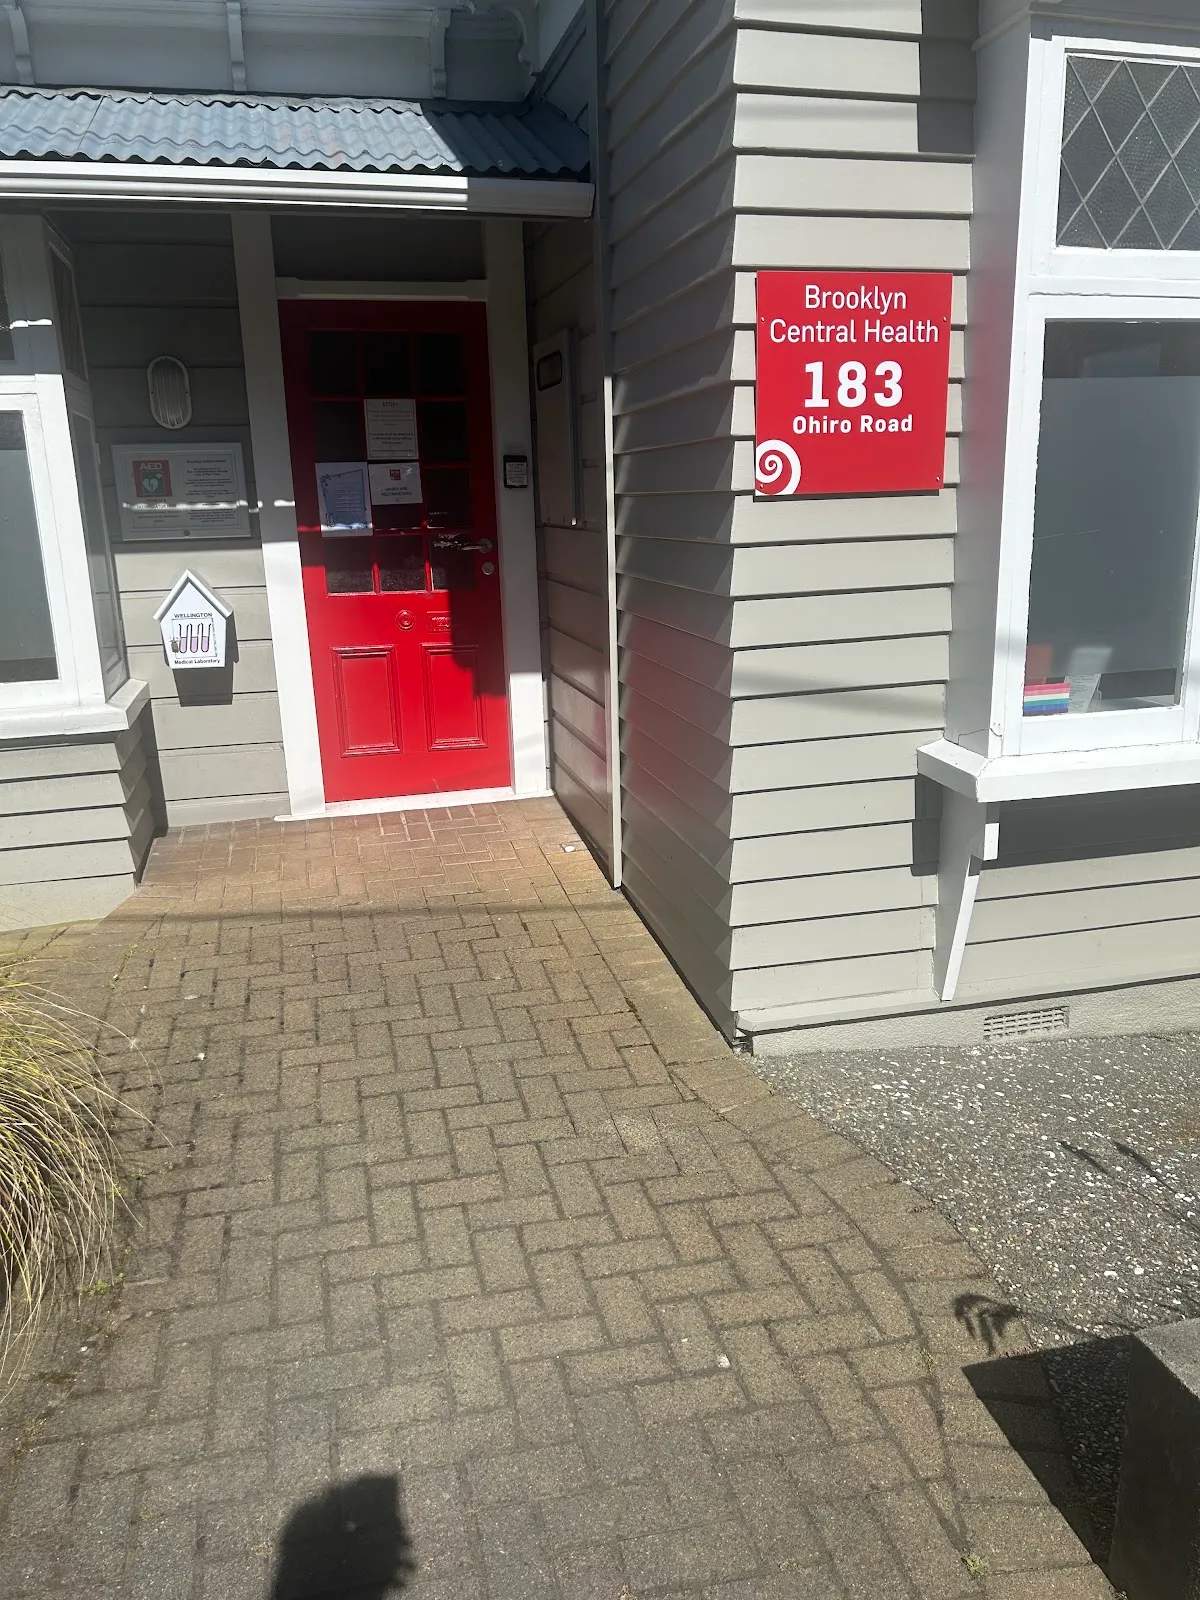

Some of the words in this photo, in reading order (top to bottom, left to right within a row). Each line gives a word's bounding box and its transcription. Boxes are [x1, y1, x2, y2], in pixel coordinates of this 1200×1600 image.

[805, 285, 907, 315] Brooklyn
[770, 319, 856, 343] Central
[864, 319, 939, 343] Health
[804, 360, 903, 408] 183
[792, 415, 852, 434] Ohiro
[860, 414, 913, 433] Road
[140, 462, 163, 470] AED
